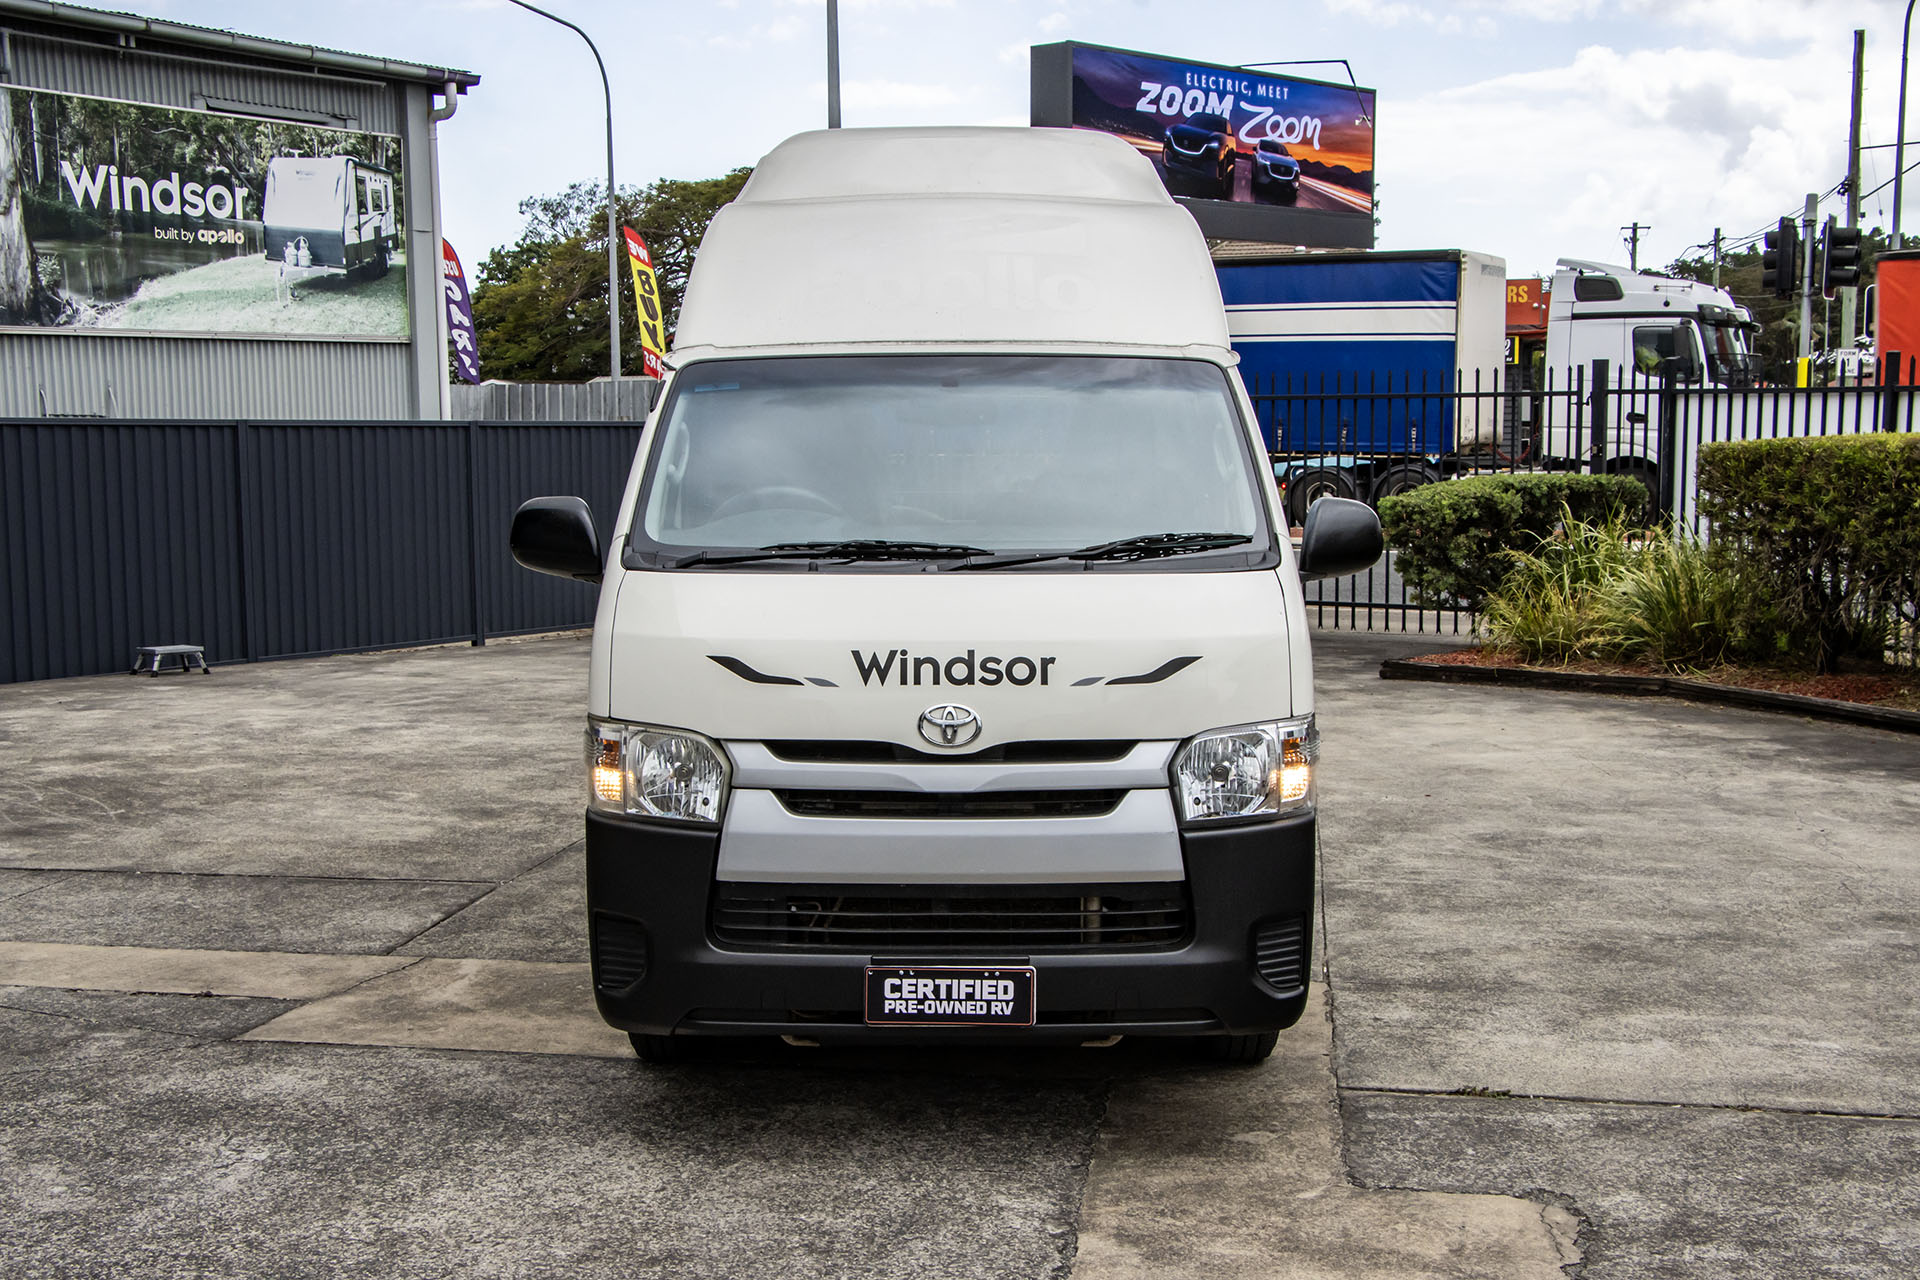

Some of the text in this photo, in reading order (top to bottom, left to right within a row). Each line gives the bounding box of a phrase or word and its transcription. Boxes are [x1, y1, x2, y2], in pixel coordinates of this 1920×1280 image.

[1186, 72, 1289, 101] ELECTRIC, MEET
[1135, 81, 1235, 120] ZOOM
[60, 160, 249, 220] Windsor
[154, 226, 244, 245] built by apollo
[1507, 285, 1528, 303] RS
[850, 648, 1057, 687] Windsor
[883, 977, 1015, 1001] CERTIFIED
[883, 1000, 1014, 1016] PRE-OWNED RV
